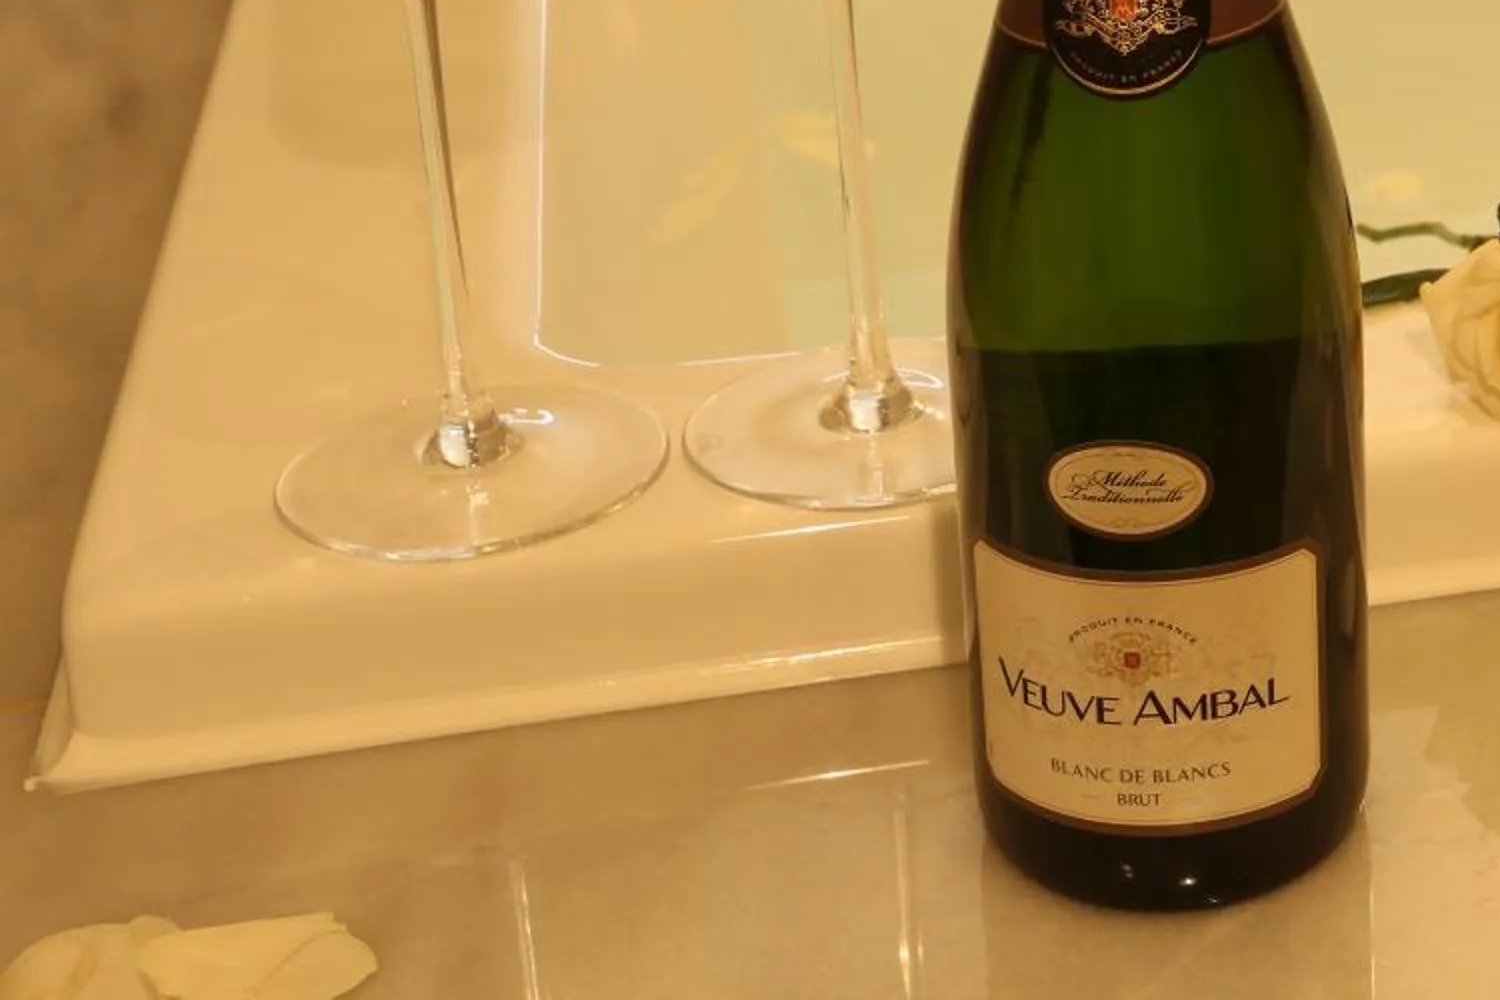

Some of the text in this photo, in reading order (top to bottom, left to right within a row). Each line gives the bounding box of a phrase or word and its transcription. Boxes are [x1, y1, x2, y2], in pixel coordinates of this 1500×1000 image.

[1069, 617, 1197, 645] PRODUIT EN FRANCE
[998, 656, 1291, 726] VEUVE AMBAL
[1050, 757, 1232, 785] BLANC DE BLANCS
[1117, 792, 1163, 807] BRUT
